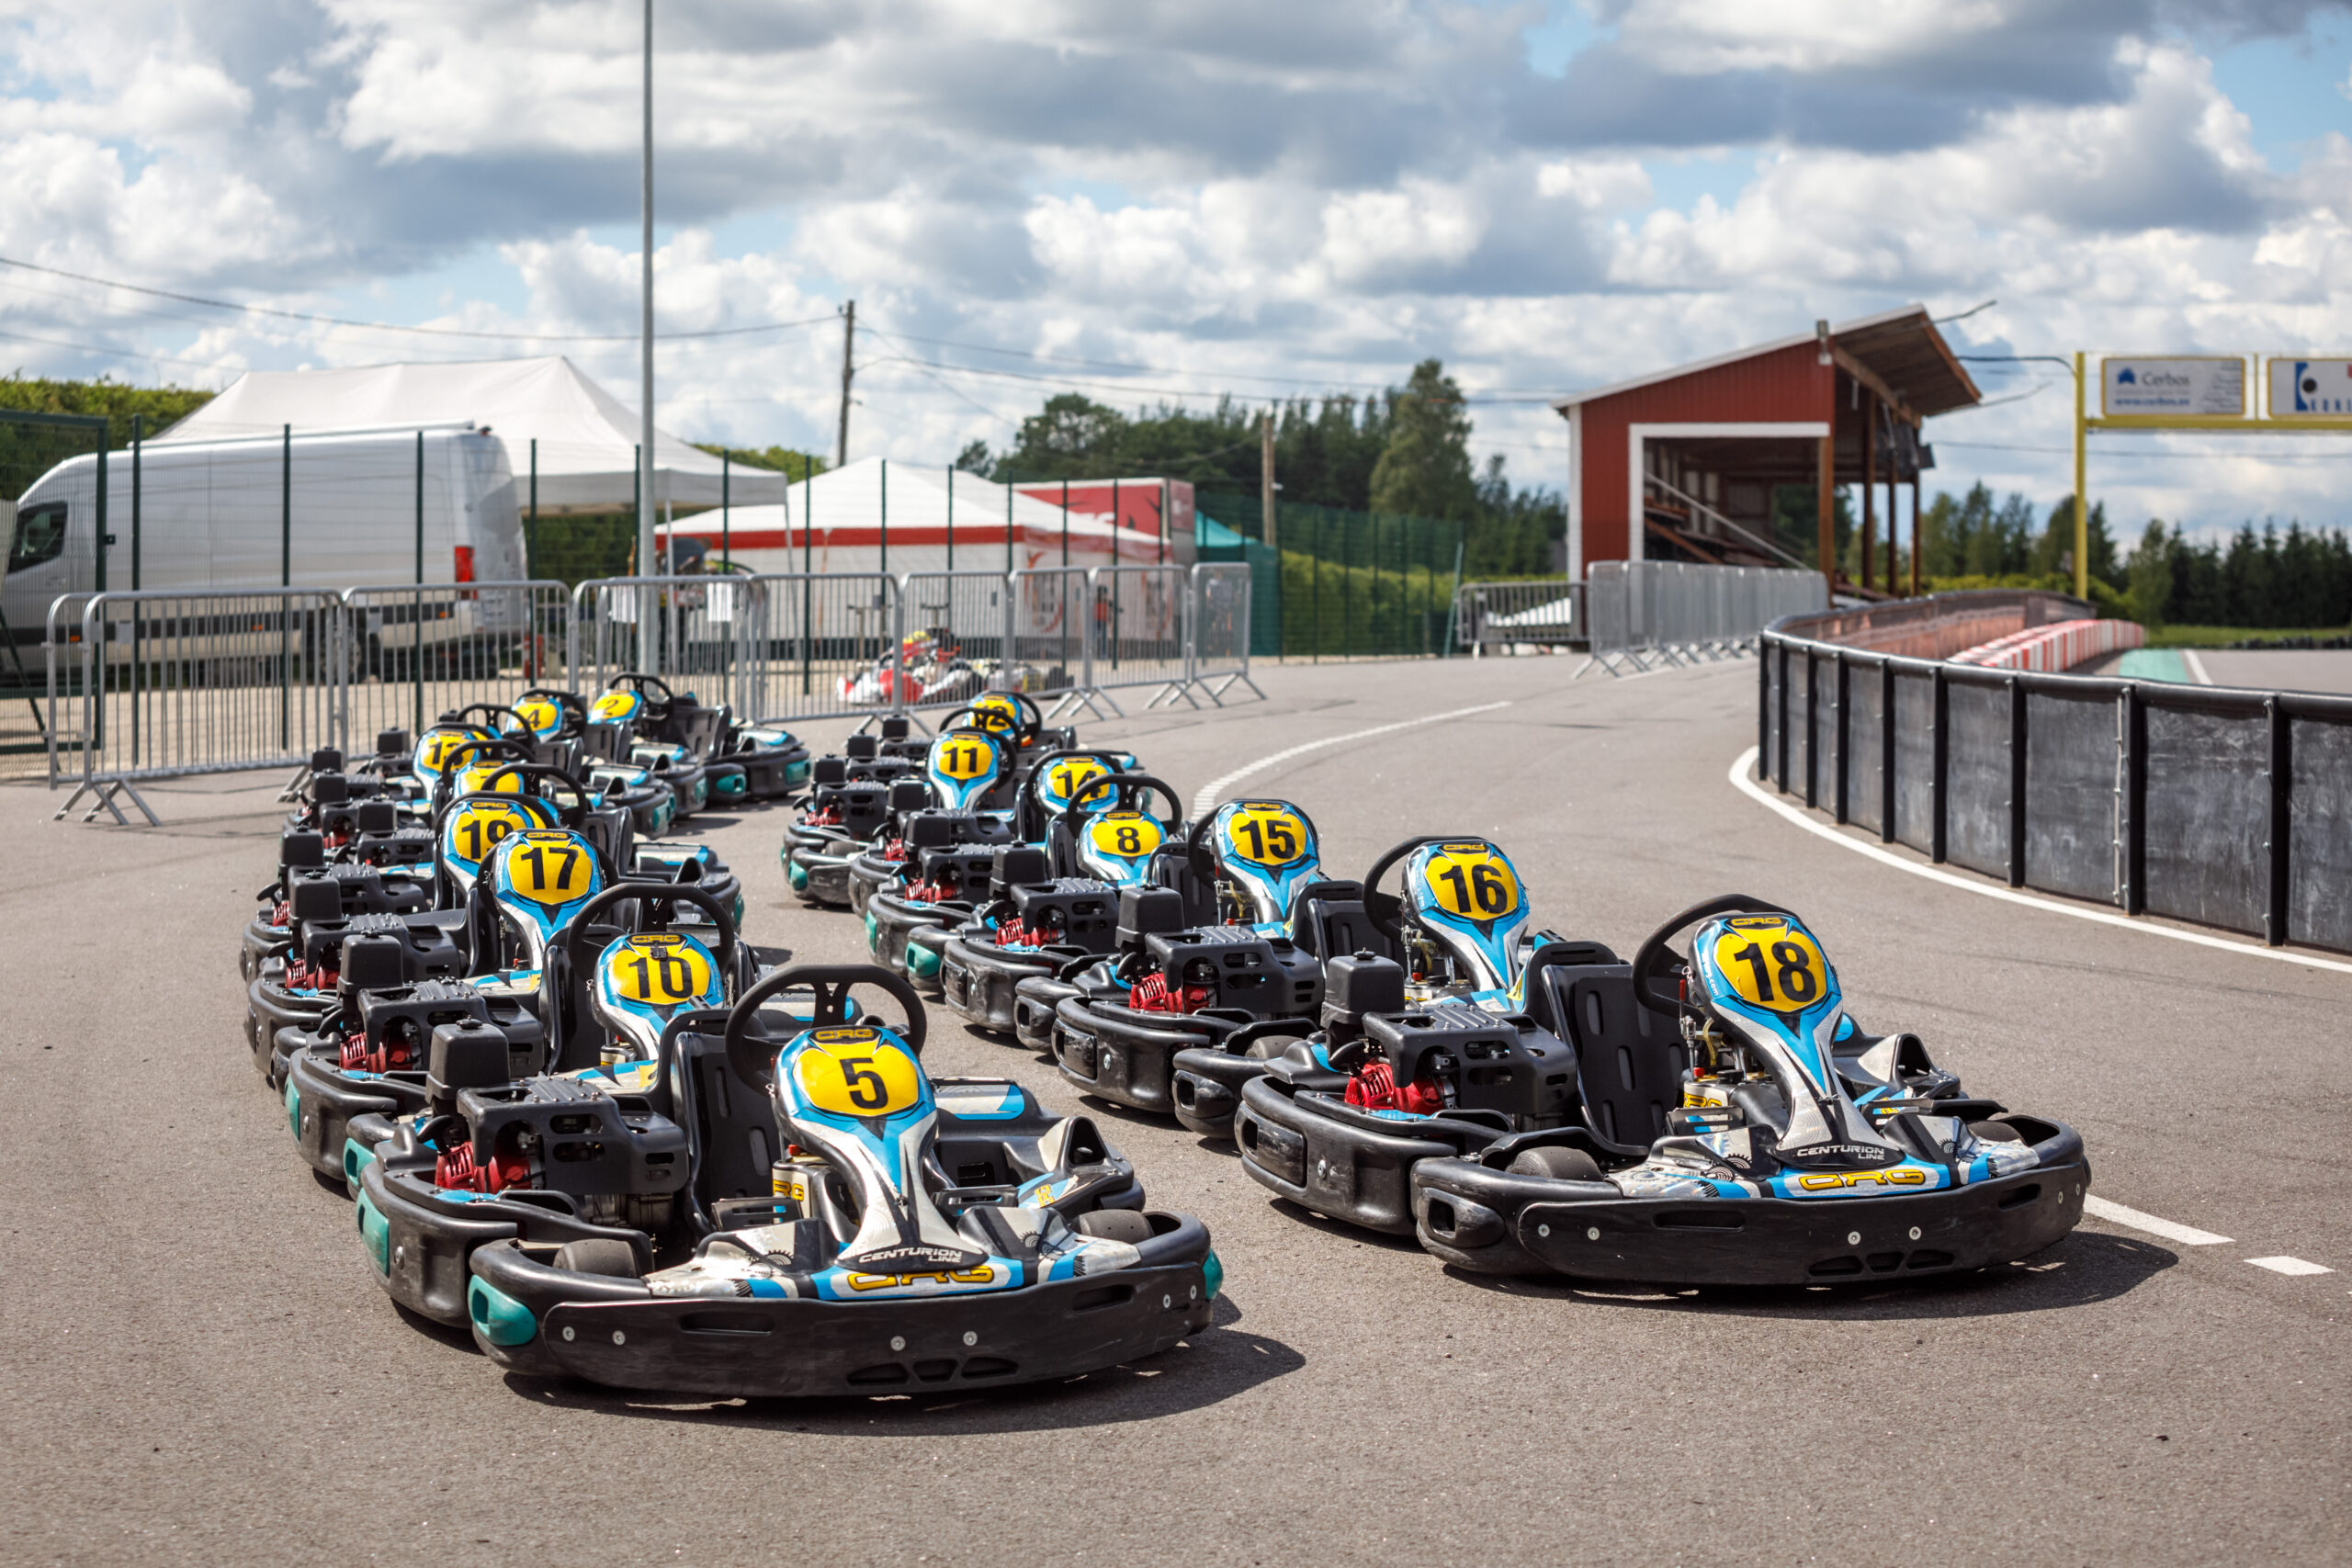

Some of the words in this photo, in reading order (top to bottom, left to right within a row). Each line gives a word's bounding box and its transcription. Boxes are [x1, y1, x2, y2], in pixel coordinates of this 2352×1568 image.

[526, 709, 541, 728] 4
[603, 699, 618, 716] 2
[944, 746, 978, 773] 11
[1057, 770, 1102, 798] 14
[462, 819, 514, 860] 19
[1116, 827, 1141, 853] 8
[1238, 818, 1296, 859] 15
[1442, 843, 1486, 852] CRG
[521, 846, 579, 890] 17
[1440, 863, 1508, 914] 16
[1731, 917, 1782, 926] CRG
[631, 934, 681, 943] CRG
[628, 956, 694, 999] 10
[1734, 941, 1816, 1002] 18
[815, 1028, 874, 1041] CRG
[839, 1057, 888, 1110] 5
[1797, 1145, 1884, 1157] CENTURION
[1858, 1153, 1885, 1161] LINE
[1798, 1168, 1927, 1191] CRG
[858, 1247, 963, 1264] CENTURION
[928, 1254, 962, 1264] LINE
[847, 1265, 995, 1292] CRG
